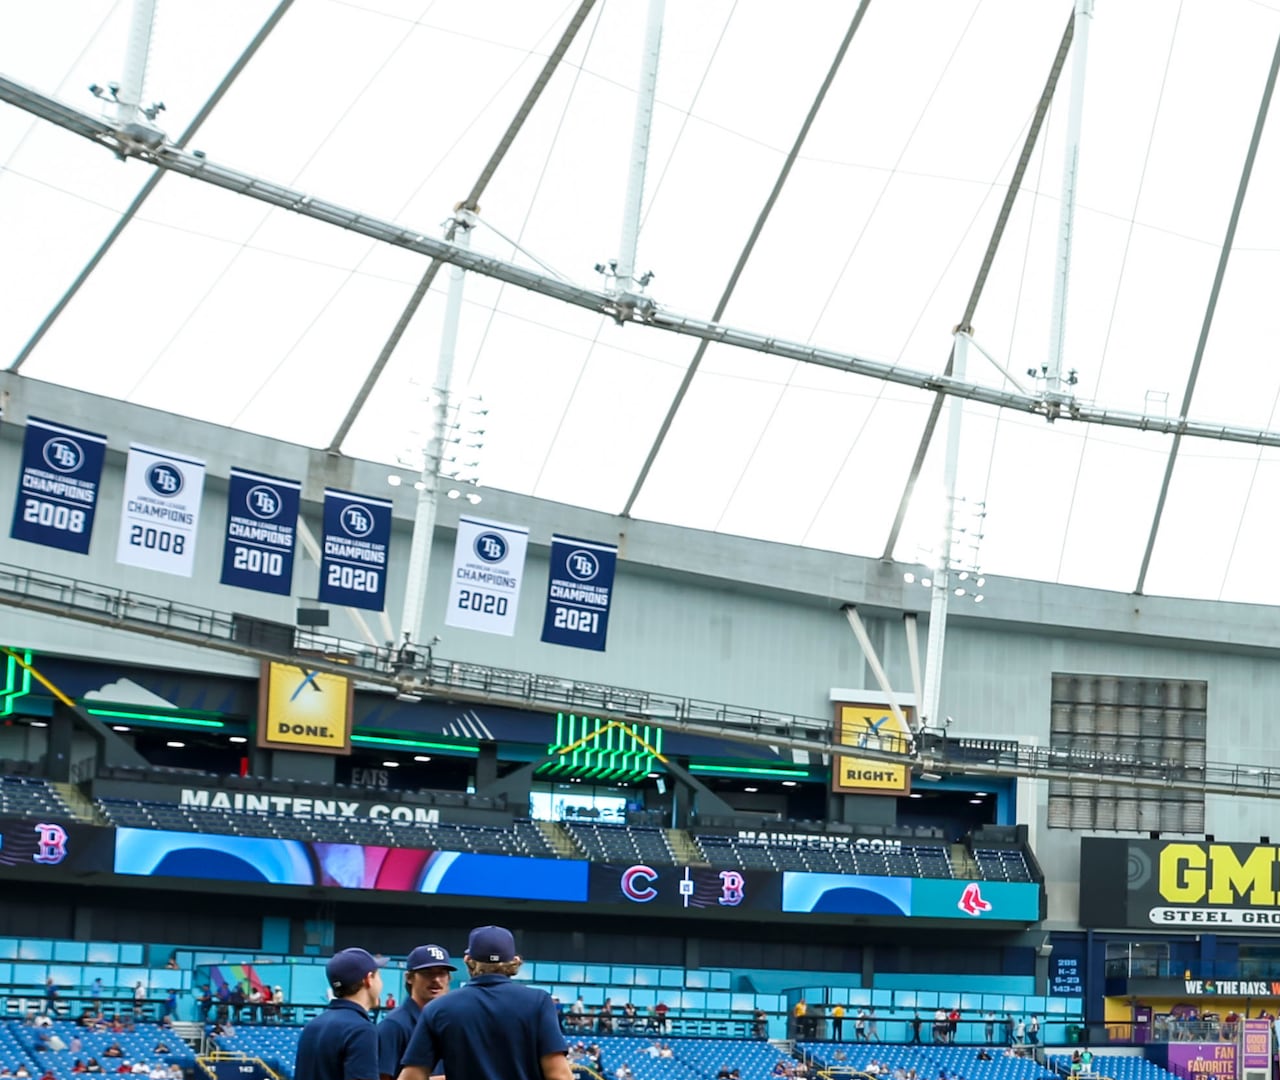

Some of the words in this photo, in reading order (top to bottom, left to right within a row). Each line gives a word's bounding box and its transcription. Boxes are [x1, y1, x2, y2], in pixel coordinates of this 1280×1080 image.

[23, 474, 95, 502] CHAMPIONS
[24, 500, 85, 533] 2008
[128, 500, 193, 525] CHAMPIONS
[130, 525, 185, 555] 2008
[229, 523, 292, 546] CHAMPIONS
[234, 547, 283, 576] 2010
[325, 542, 385, 564] CHAMPIONS
[328, 564, 379, 593] 2020
[456, 568, 517, 589] CHAMPIONS
[458, 590, 508, 616] 2020
[550, 585, 609, 606] CHAMPIONS
[554, 607, 599, 634] 2021
[278, 723, 334, 738] DONE.
[351, 768, 389, 786] EATS
[846, 769, 897, 783] RIGHT.
[1163, 910, 1232, 923] STEEL
[1185, 981, 1203, 995] WE
[1215, 981, 1238, 995] THE
[1239, 981, 1270, 996] RAYS.
[1215, 1046, 1234, 1059] FAN
[1188, 1059, 1234, 1073] FAVORITE
